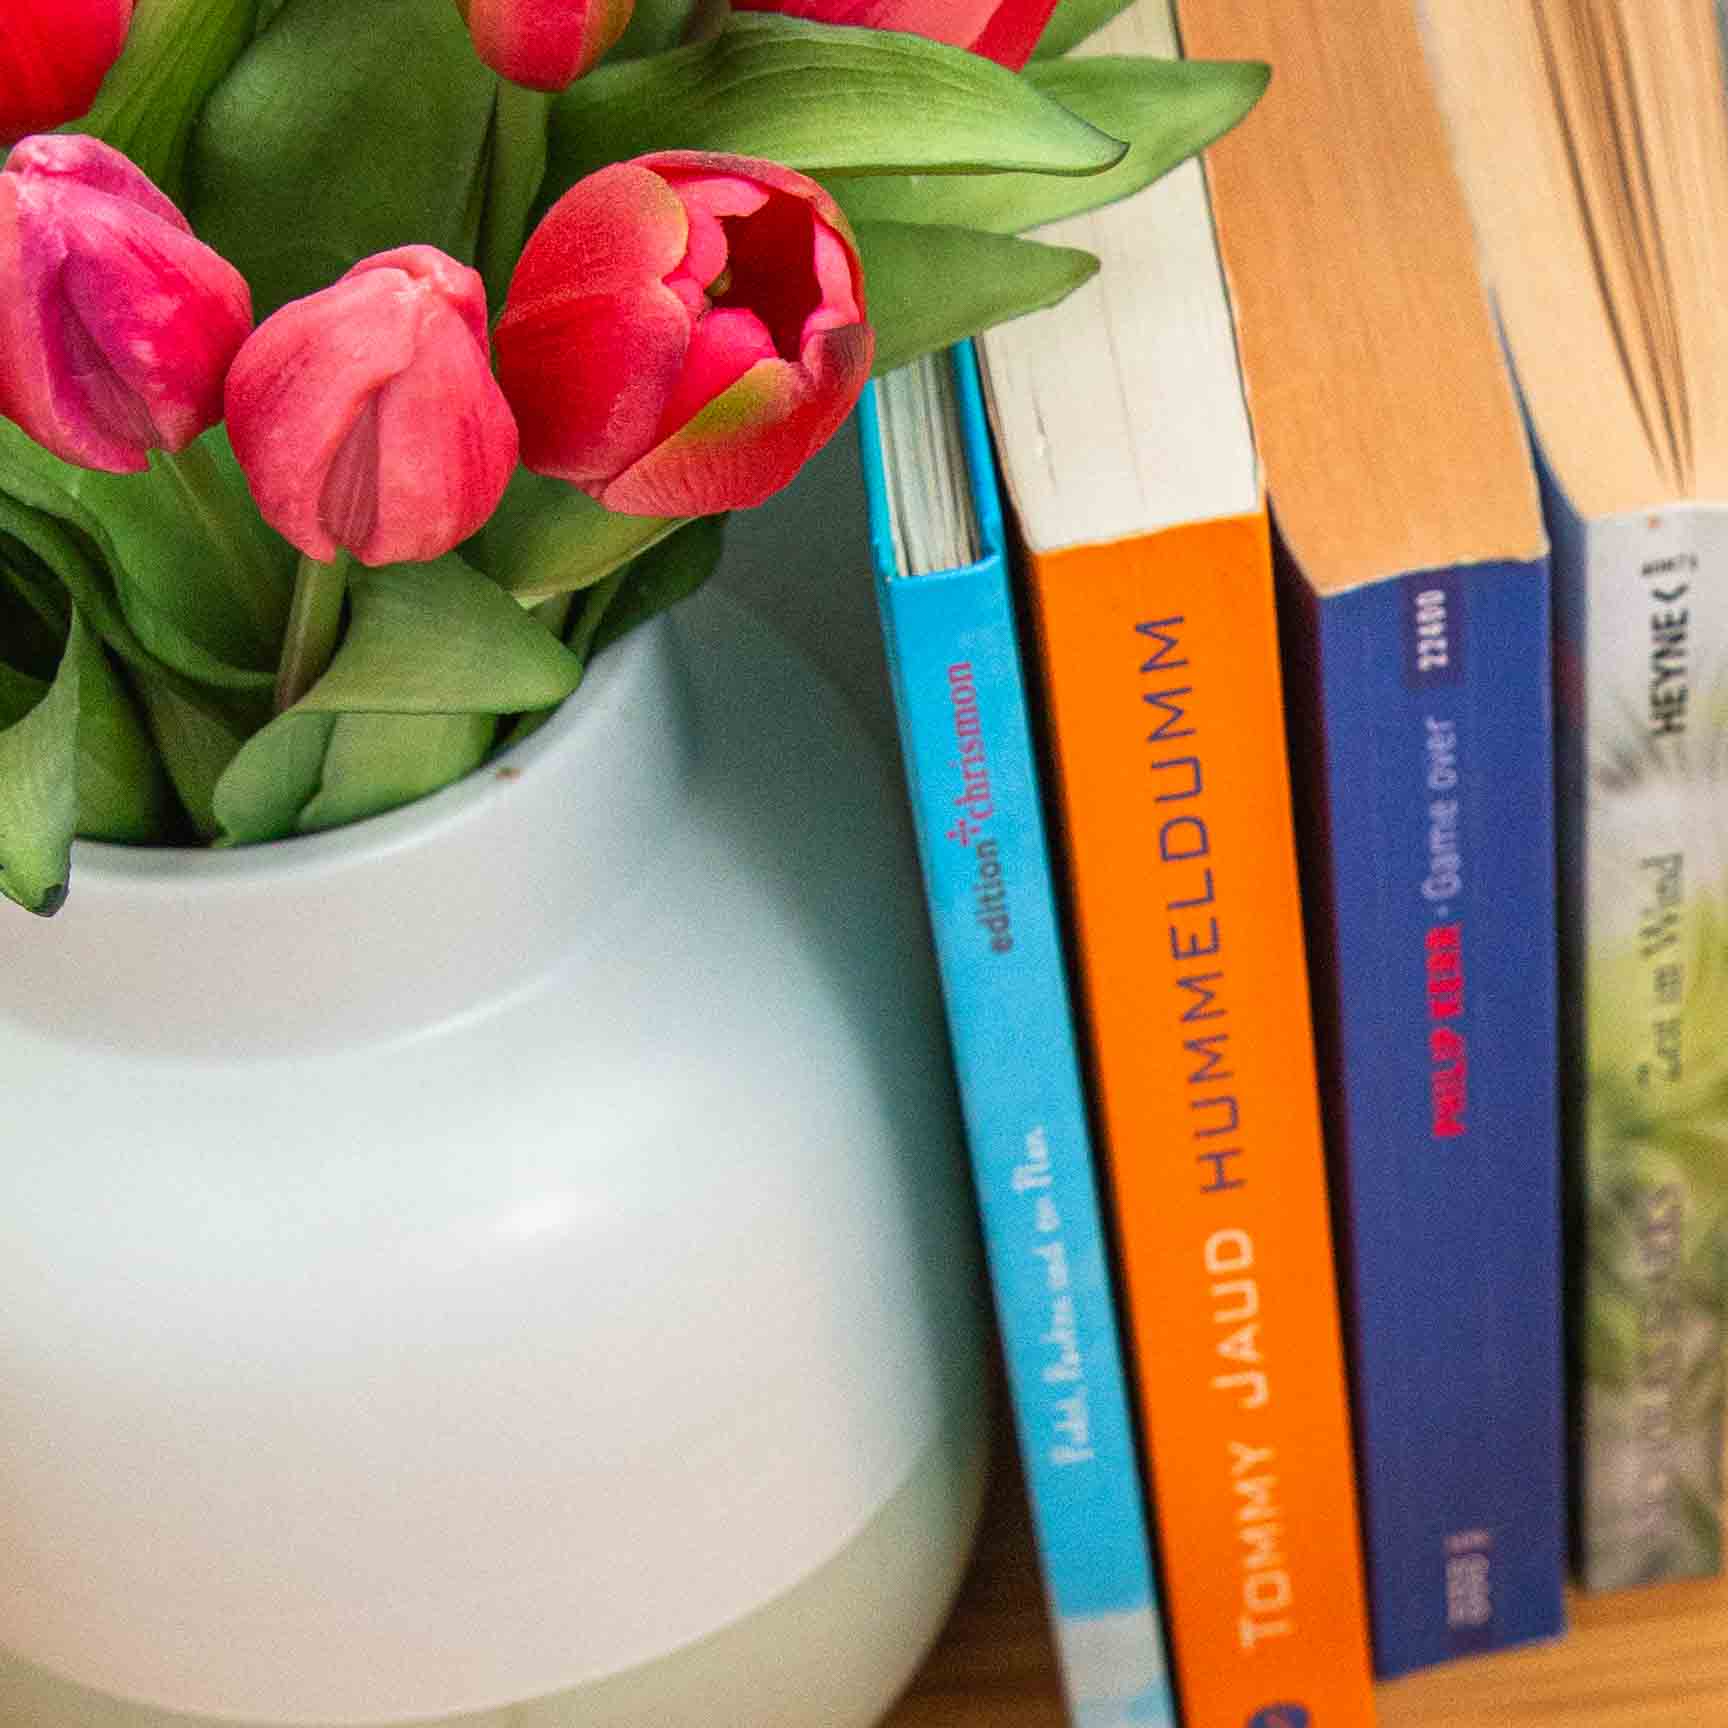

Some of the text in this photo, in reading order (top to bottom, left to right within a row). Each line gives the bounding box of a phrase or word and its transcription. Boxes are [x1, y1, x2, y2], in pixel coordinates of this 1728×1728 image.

[947, 661, 994, 822] chrismon
[1427, 715, 1458, 791] over
[1134, 613, 1247, 1195] HUMMELDUMM
[1421, 800, 1460, 903] Game
[1203, 1227, 1295, 1651] TOMMY JAUD
